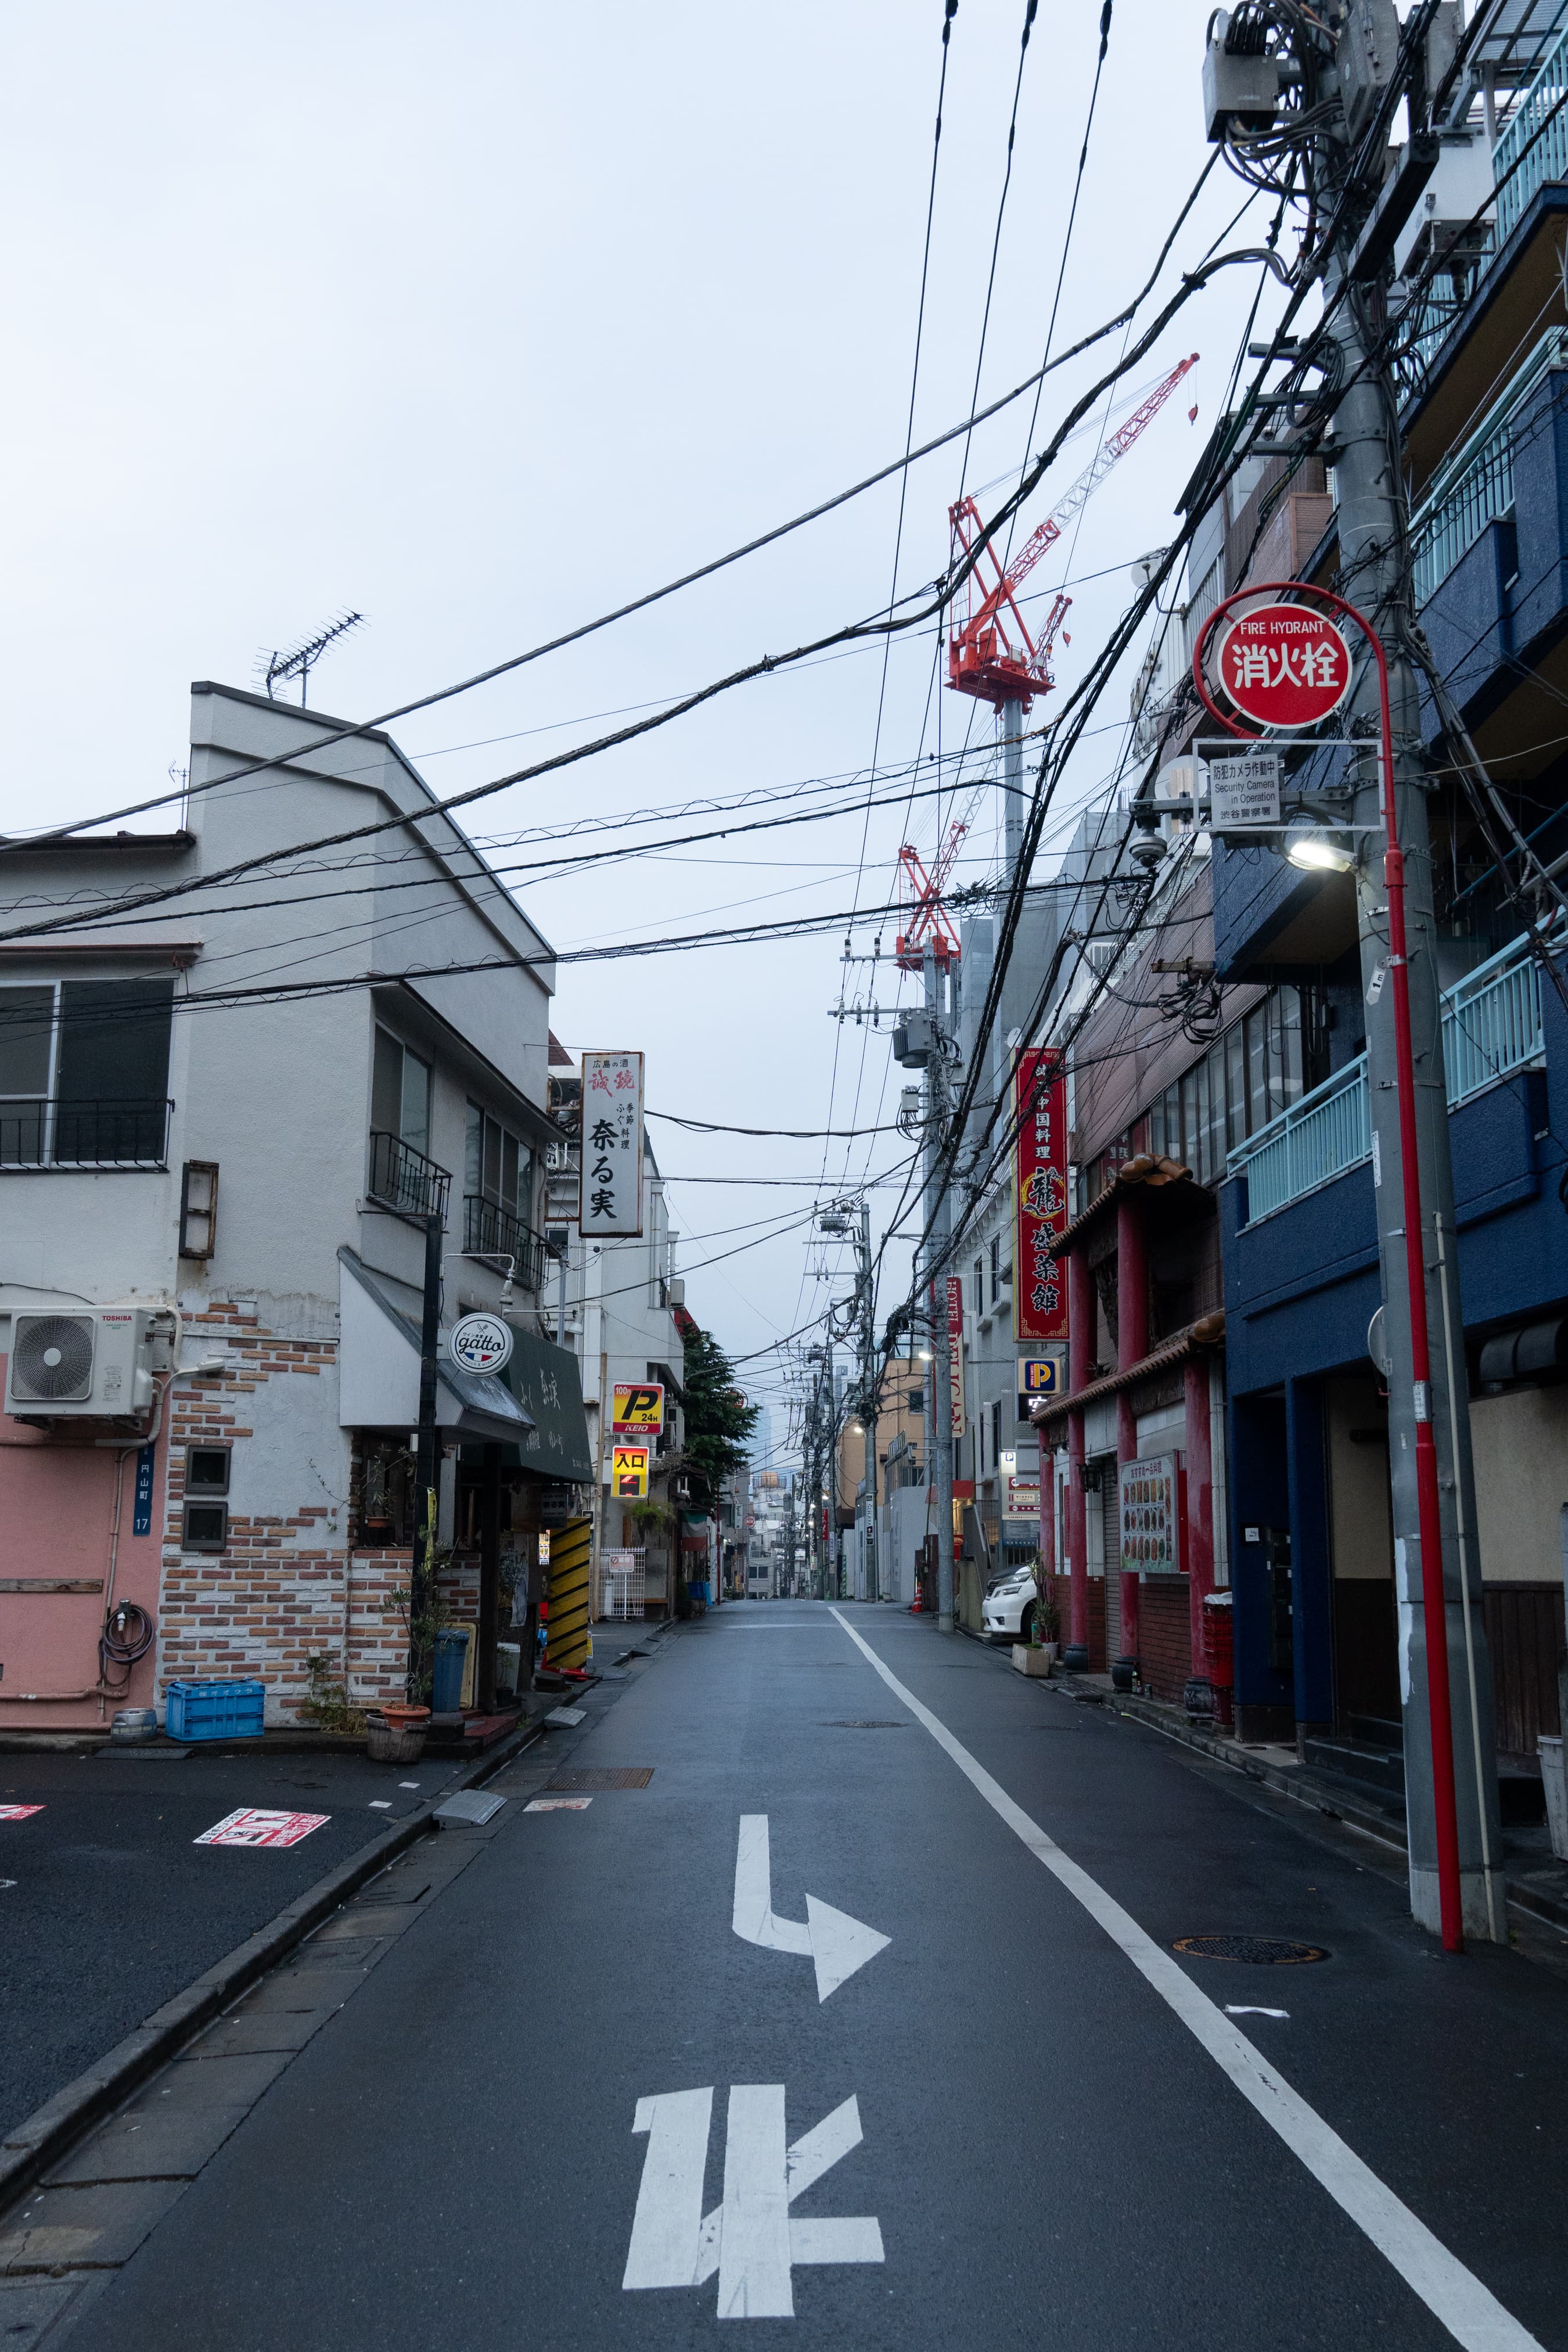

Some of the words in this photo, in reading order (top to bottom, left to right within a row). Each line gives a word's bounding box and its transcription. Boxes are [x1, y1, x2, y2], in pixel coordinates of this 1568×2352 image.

[1240, 622, 1266, 634] FIRE
[1270, 621, 1325, 634] HYDRANT
[1232, 641, 1339, 689] 消火栓
[1213, 760, 1275, 780] 防犯カメラ作動中
[1215, 782, 1244, 793] Security
[1247, 780, 1274, 790] Camera
[1231, 795, 1238, 804] in
[1240, 792, 1275, 804] Operation
[1220, 806, 1271, 820] 渋谷警察署
[592, 1059, 629, 1069] 広島の酒
[1035, 1064, 1052, 1159] 中国料理
[588, 1119, 620, 1219] 奈る実
[459, 1335, 502, 1354] gatto
[615, 1386, 631, 1395] 100円
[621, 1390, 659, 1420] P
[641, 1414, 658, 1422] 24H
[616, 1453, 645, 1469] 入口
[139, 1465, 149, 1499] 円山町
[136, 1519, 148, 1530] 17
